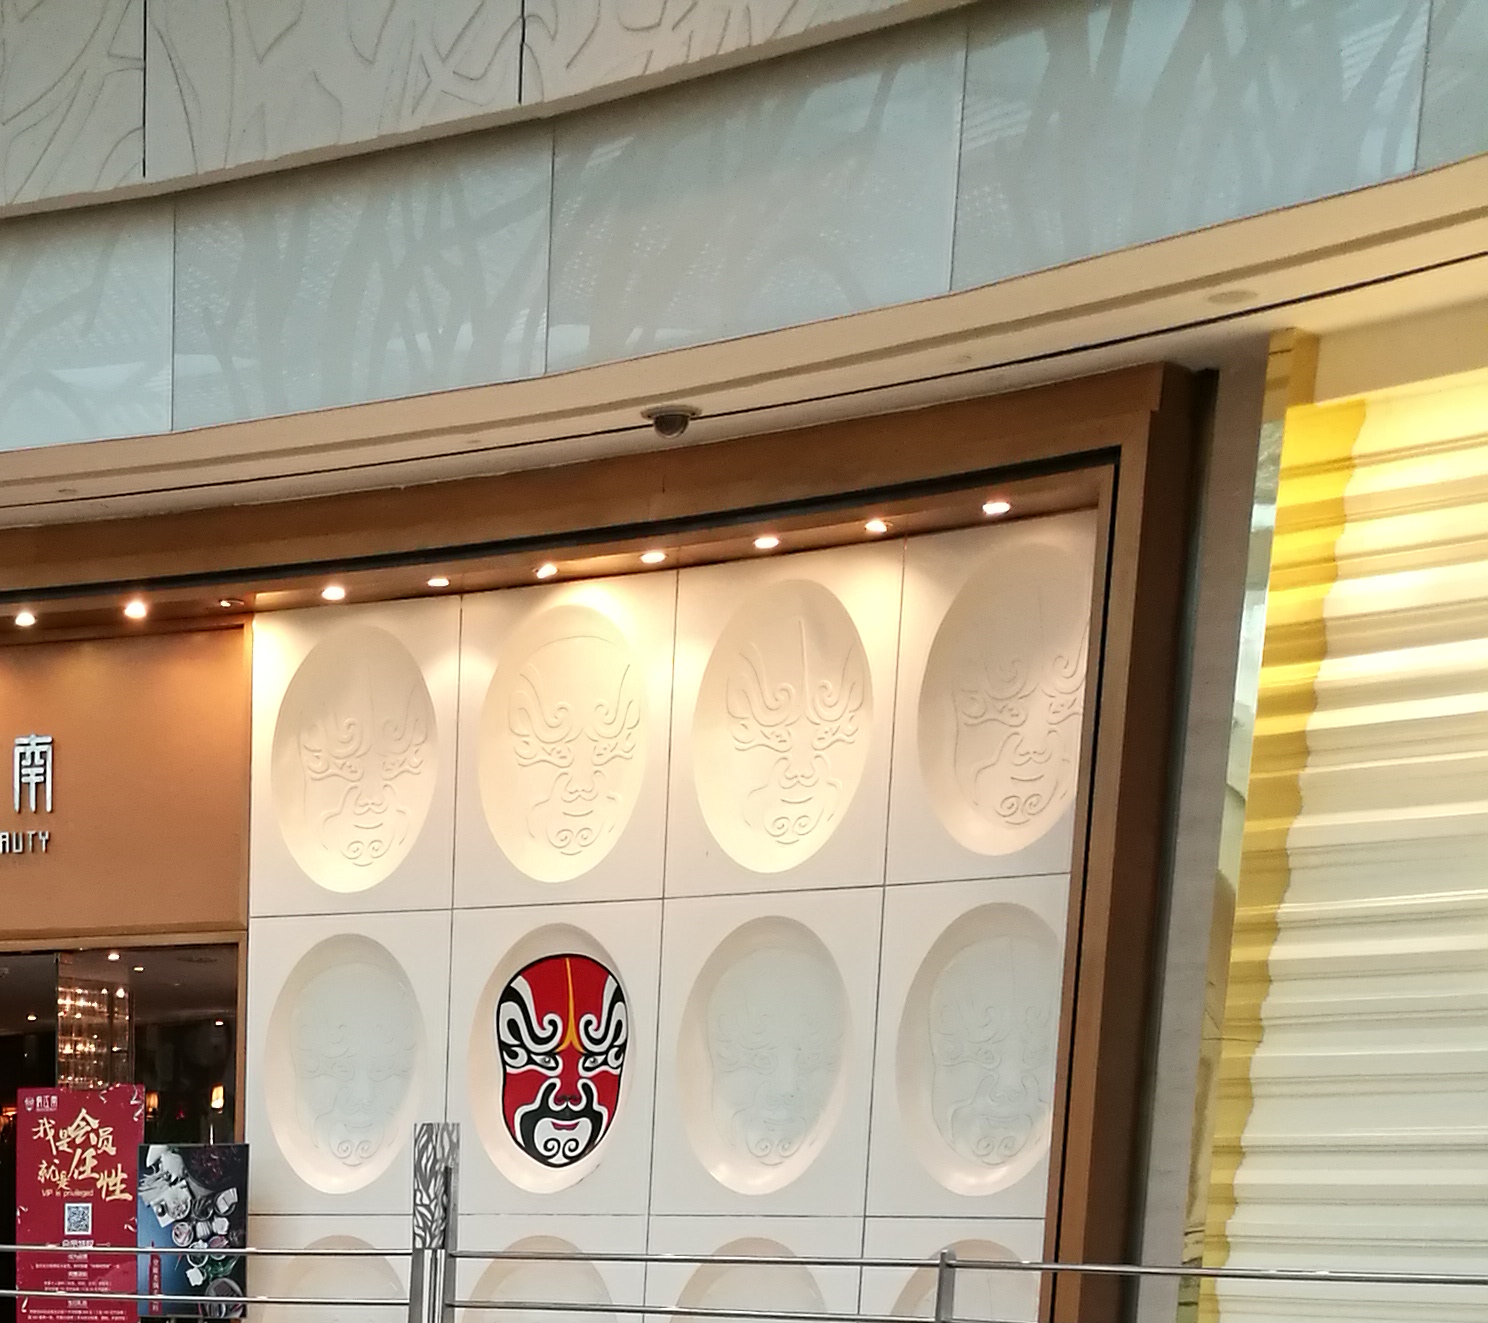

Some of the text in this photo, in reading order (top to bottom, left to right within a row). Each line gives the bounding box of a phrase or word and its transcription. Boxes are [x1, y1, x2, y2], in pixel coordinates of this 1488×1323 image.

[32, 1108, 116, 1156] 我是会员
[38, 1148, 133, 1202] 就是任性
